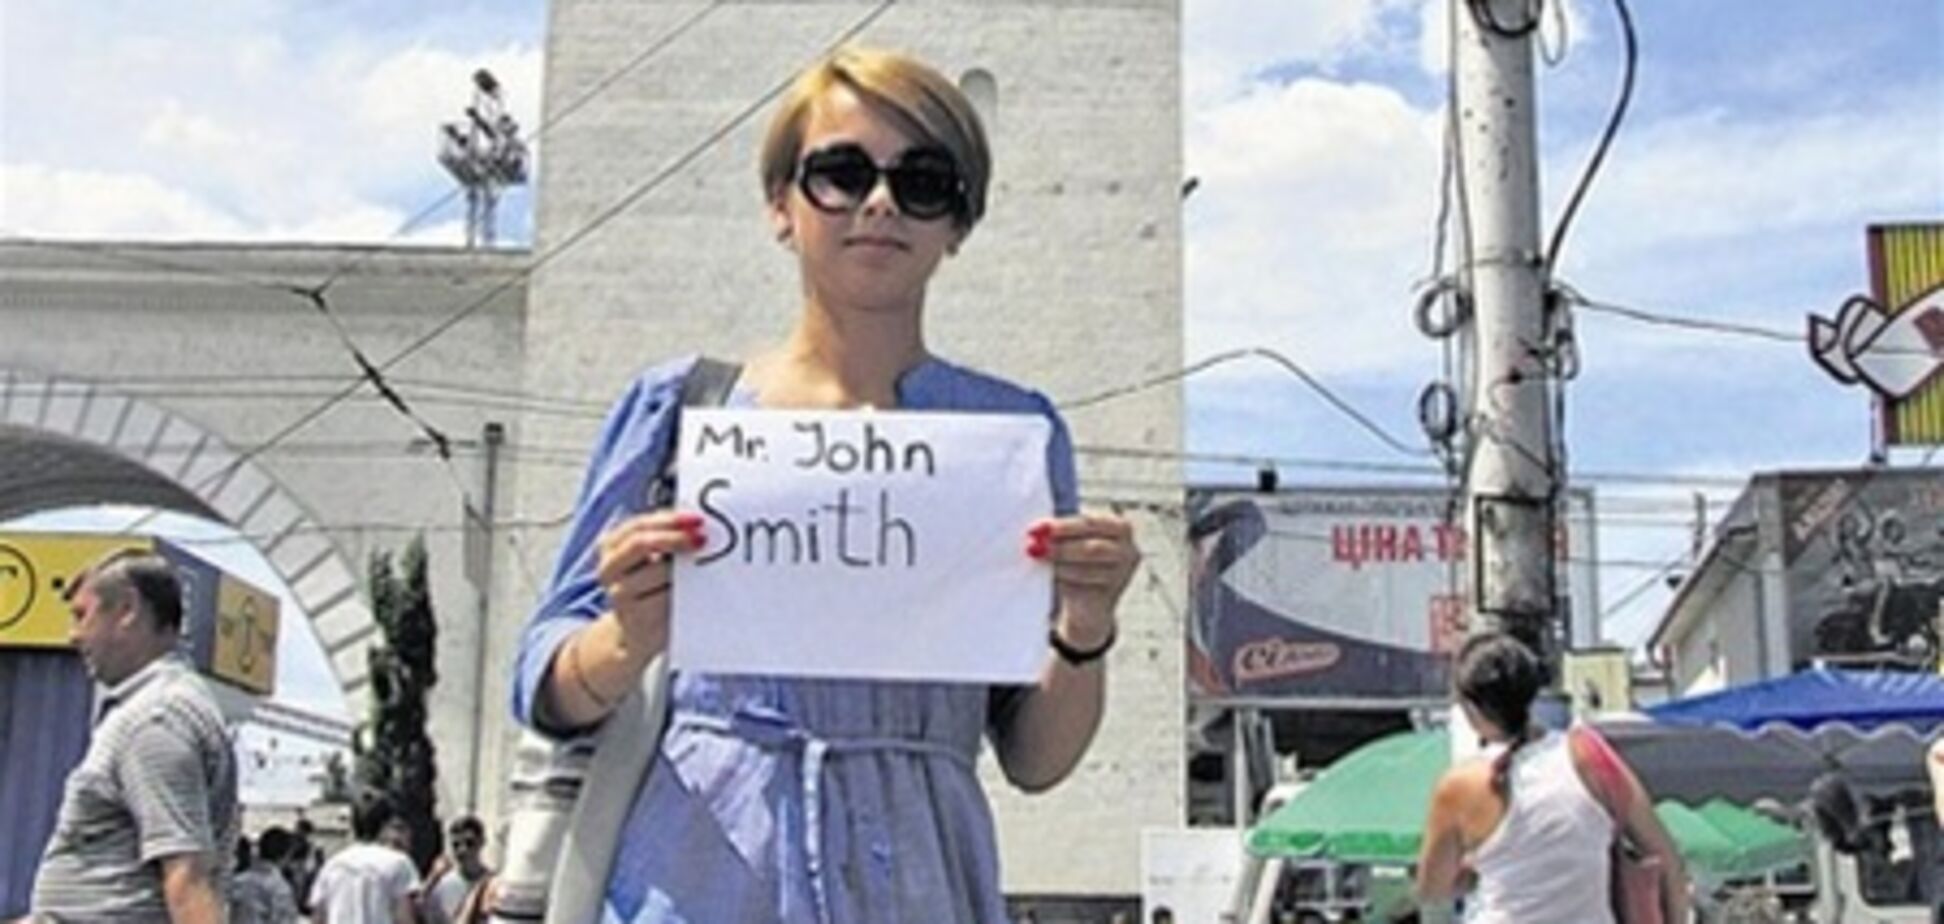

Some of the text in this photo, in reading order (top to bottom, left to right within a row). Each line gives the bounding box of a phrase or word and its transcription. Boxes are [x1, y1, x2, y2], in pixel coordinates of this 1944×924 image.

[697, 421, 936, 477] Mr. John
[695, 479, 916, 568] Smith
